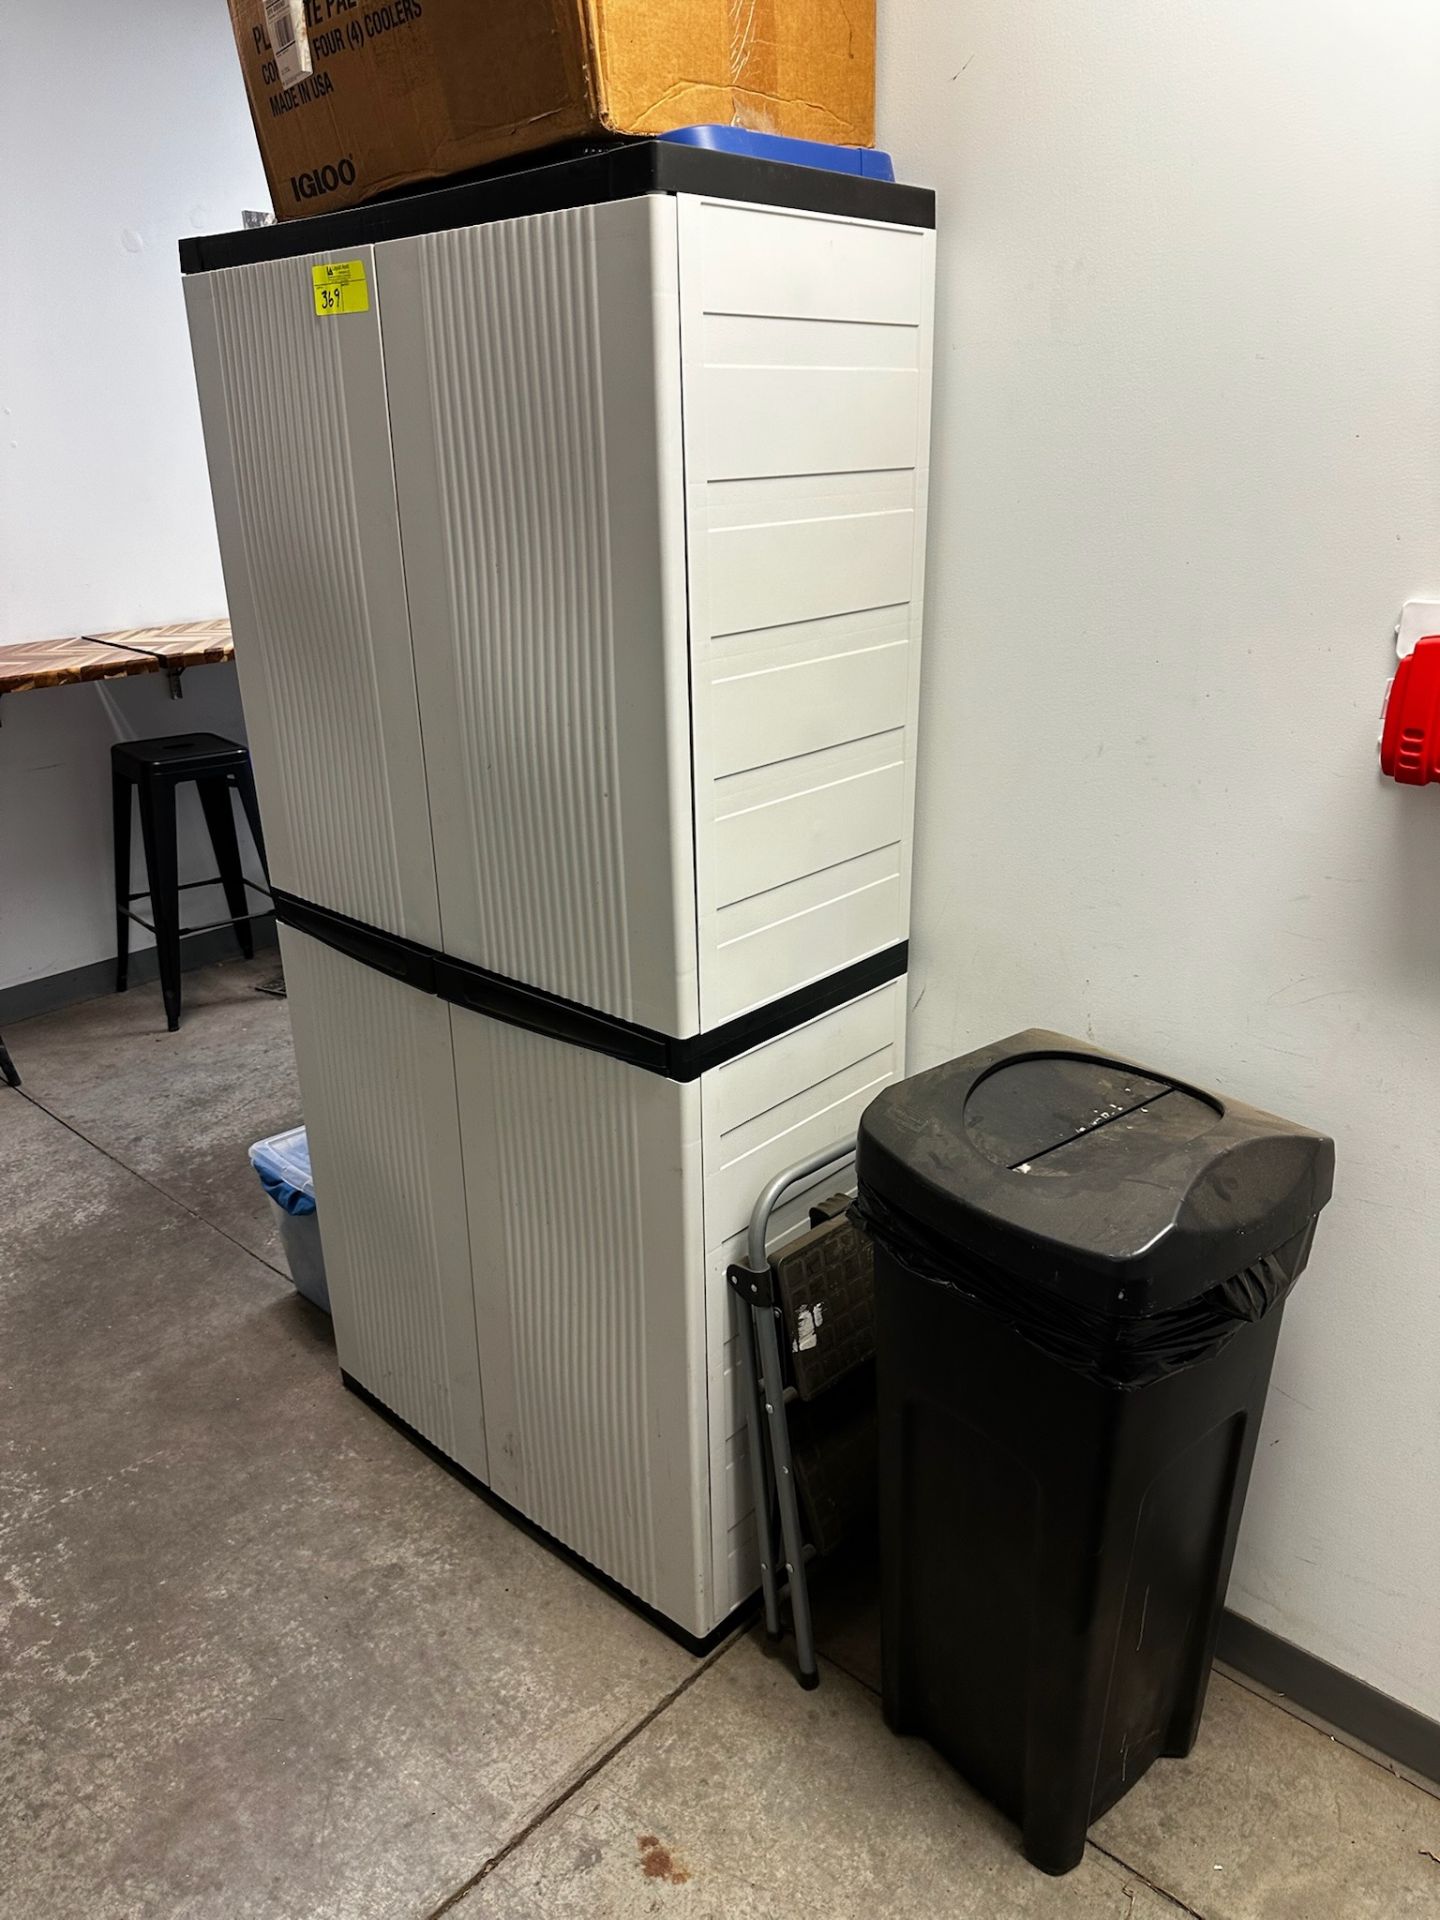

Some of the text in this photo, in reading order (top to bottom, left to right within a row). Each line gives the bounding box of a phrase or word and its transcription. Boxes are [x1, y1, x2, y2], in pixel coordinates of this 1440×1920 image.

[312, 0, 422, 60] FOUR (4) COOLERS
[269, 88, 299, 117] MADE
[299, 81, 311, 104] IN
[311, 71, 334, 99] USA
[291, 158, 356, 202] IGLOO
[321, 288, 340, 309] 369
